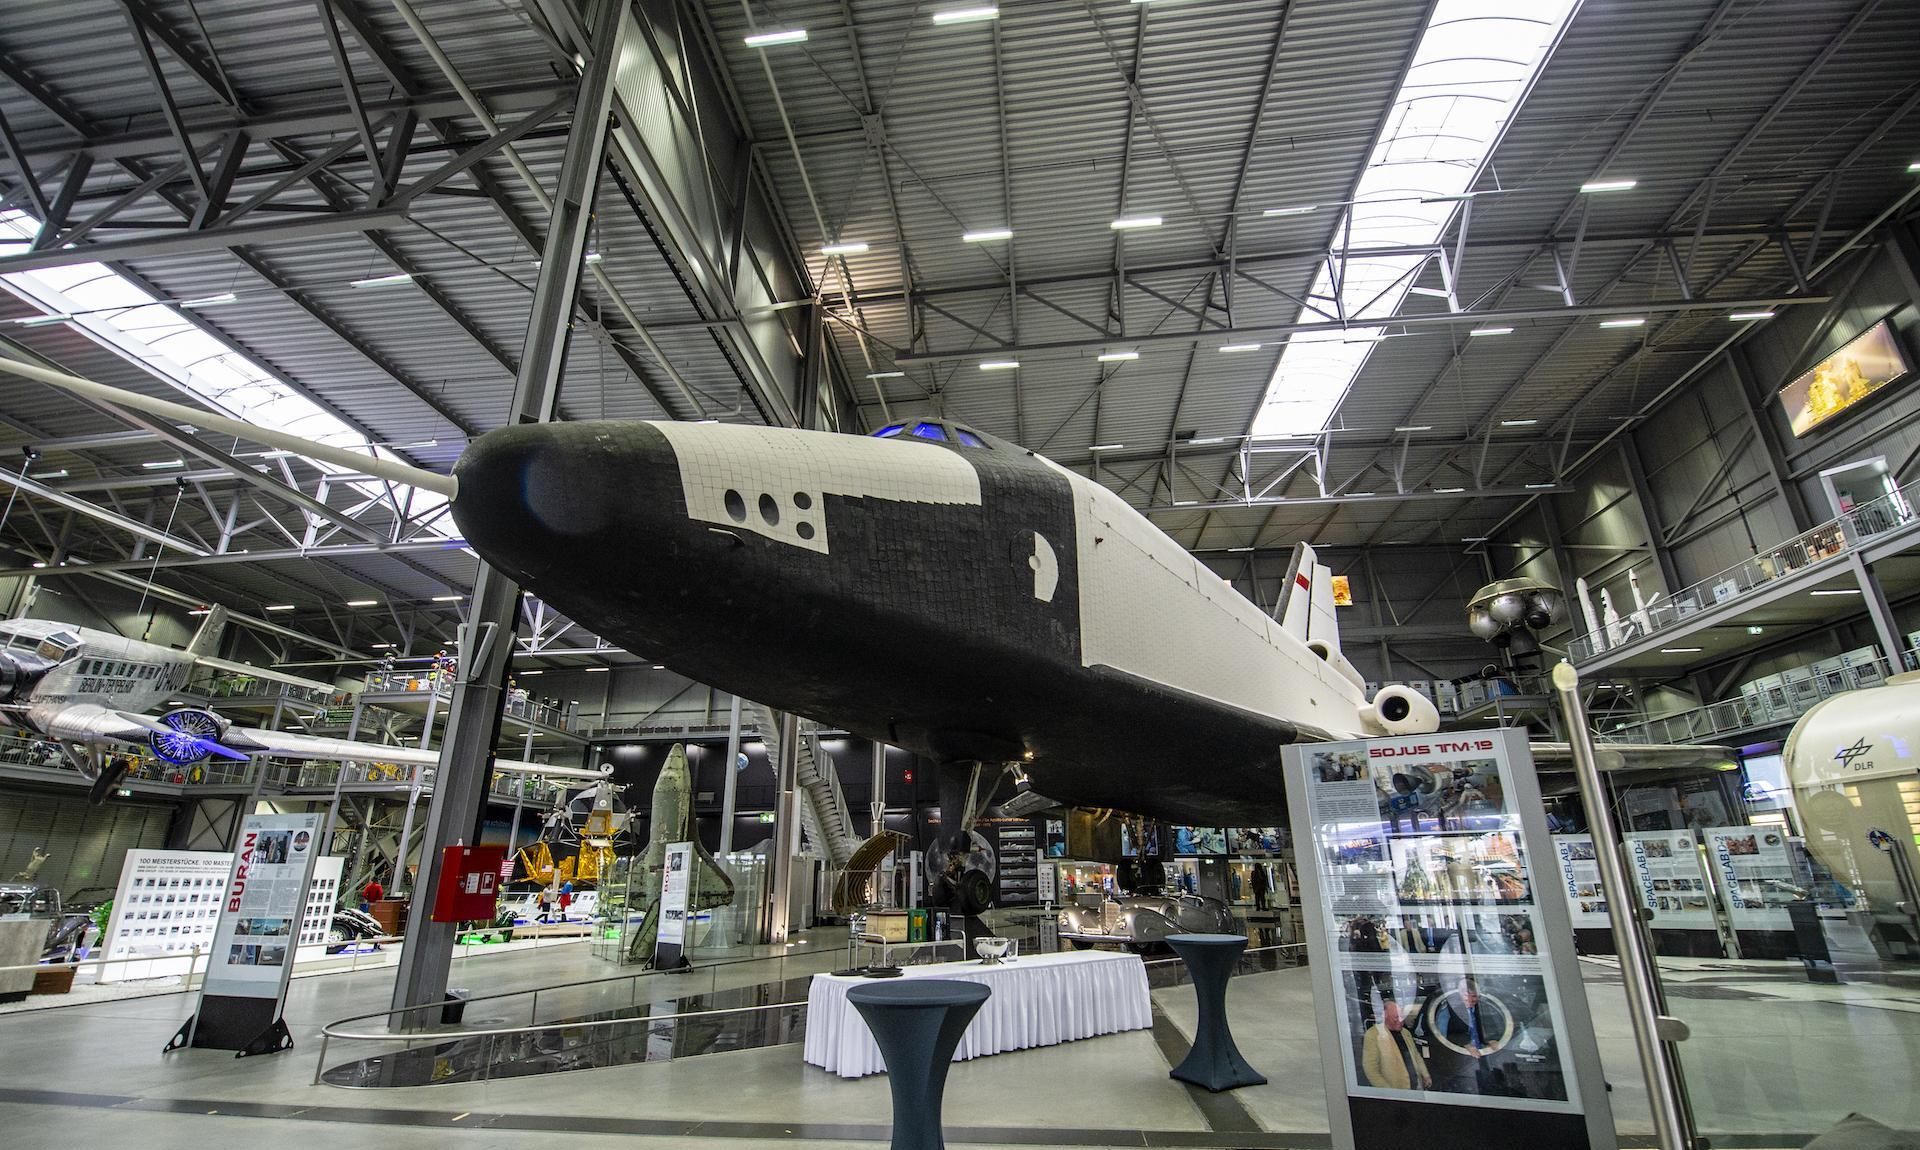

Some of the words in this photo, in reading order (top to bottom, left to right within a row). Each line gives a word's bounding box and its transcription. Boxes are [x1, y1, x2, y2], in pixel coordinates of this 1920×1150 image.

[1369, 745, 1431, 758] SOJUS
[1435, 740, 1494, 753] TM-19
[1854, 761, 1874, 771] DLR
[1714, 835, 1728, 852] D-2
[228, 833, 257, 912] BURAN
[1560, 847, 1579, 899] SPACELAB
[1637, 855, 1658, 908] SPACELAB
[1720, 854, 1744, 909] SPACELAB
